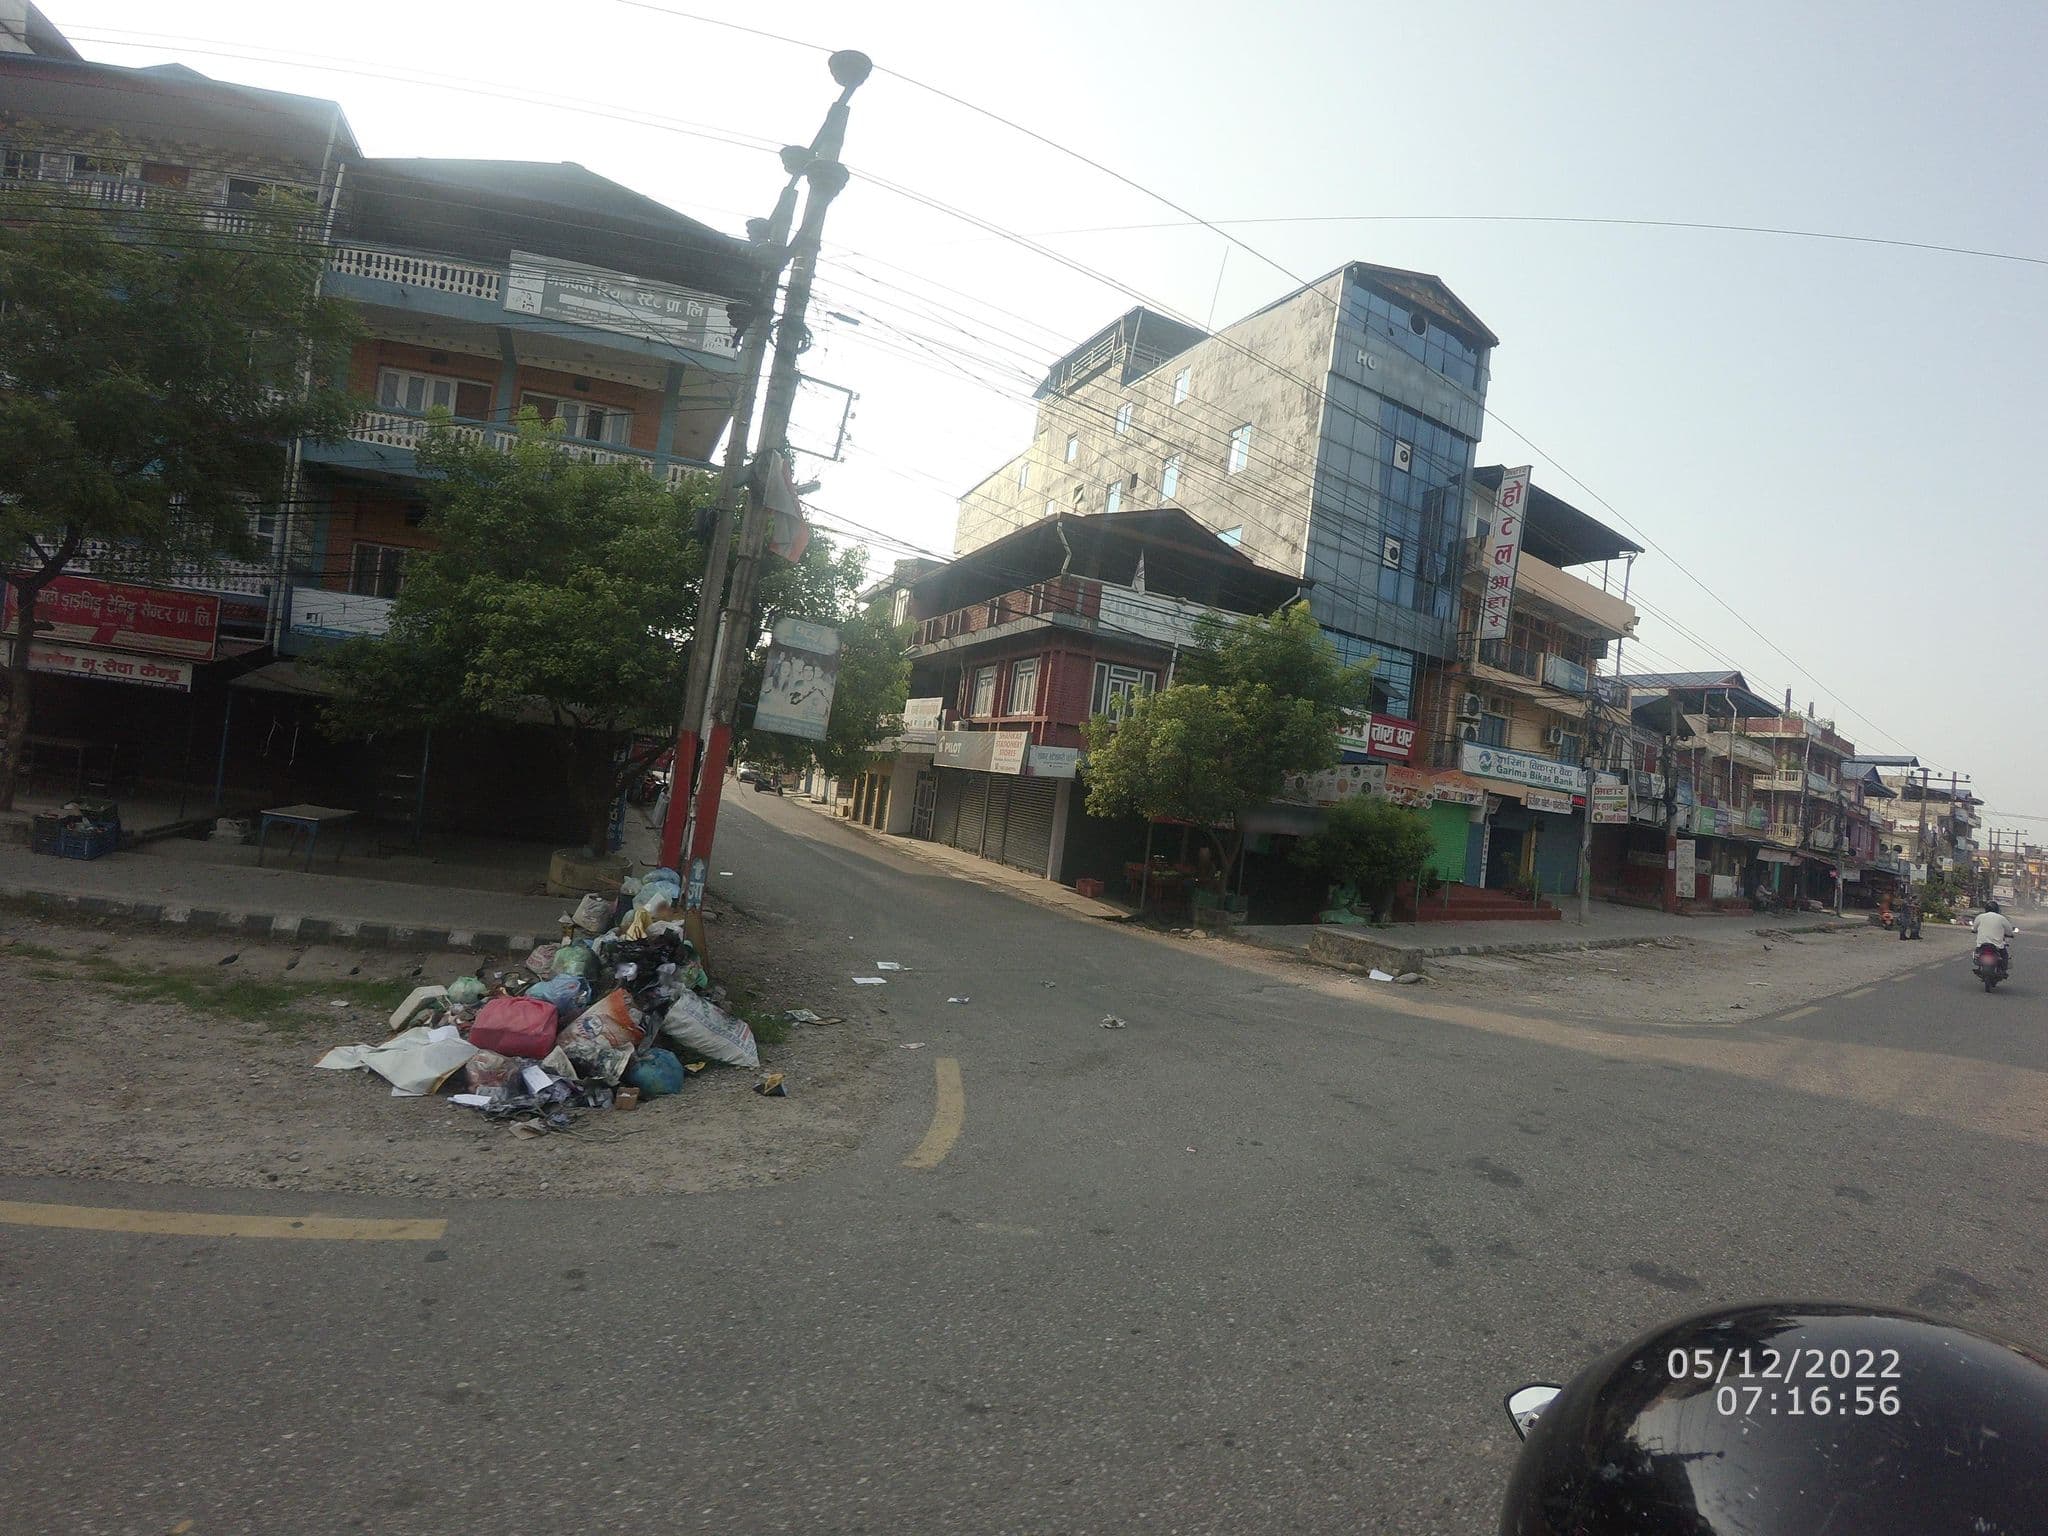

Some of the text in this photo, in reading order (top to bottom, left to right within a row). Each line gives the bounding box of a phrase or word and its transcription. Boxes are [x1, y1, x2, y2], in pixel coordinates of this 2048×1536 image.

[1496, 765, 1573, 787] Garima Bikas Bank
